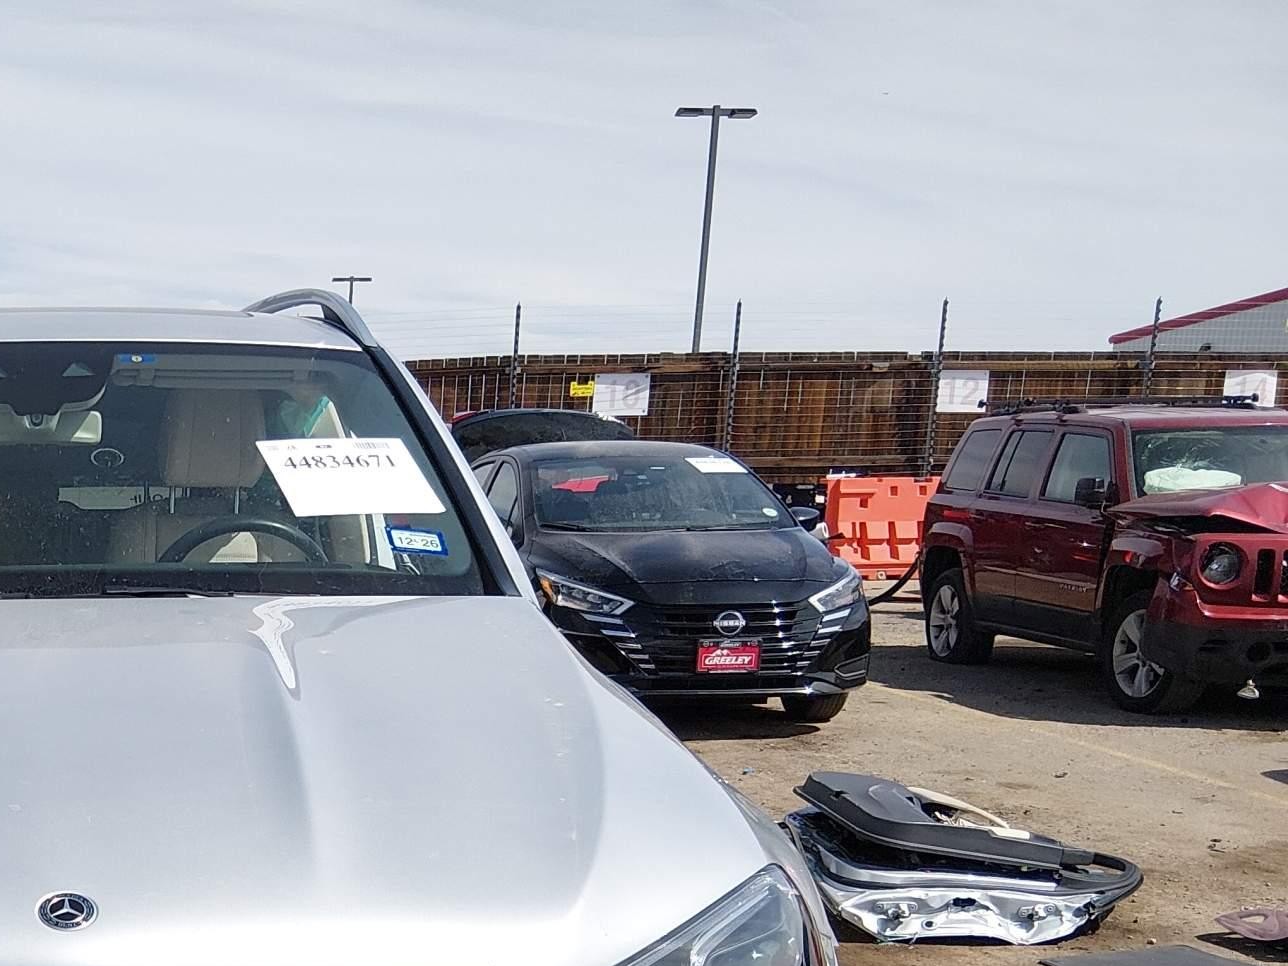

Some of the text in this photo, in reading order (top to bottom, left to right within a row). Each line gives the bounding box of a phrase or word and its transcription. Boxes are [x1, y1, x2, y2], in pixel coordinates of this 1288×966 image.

[942, 376, 980, 406] 12
[284, 454, 396, 470] 44834671
[713, 620, 746, 628] NISSAN
[704, 656, 752, 665] GREELEY
